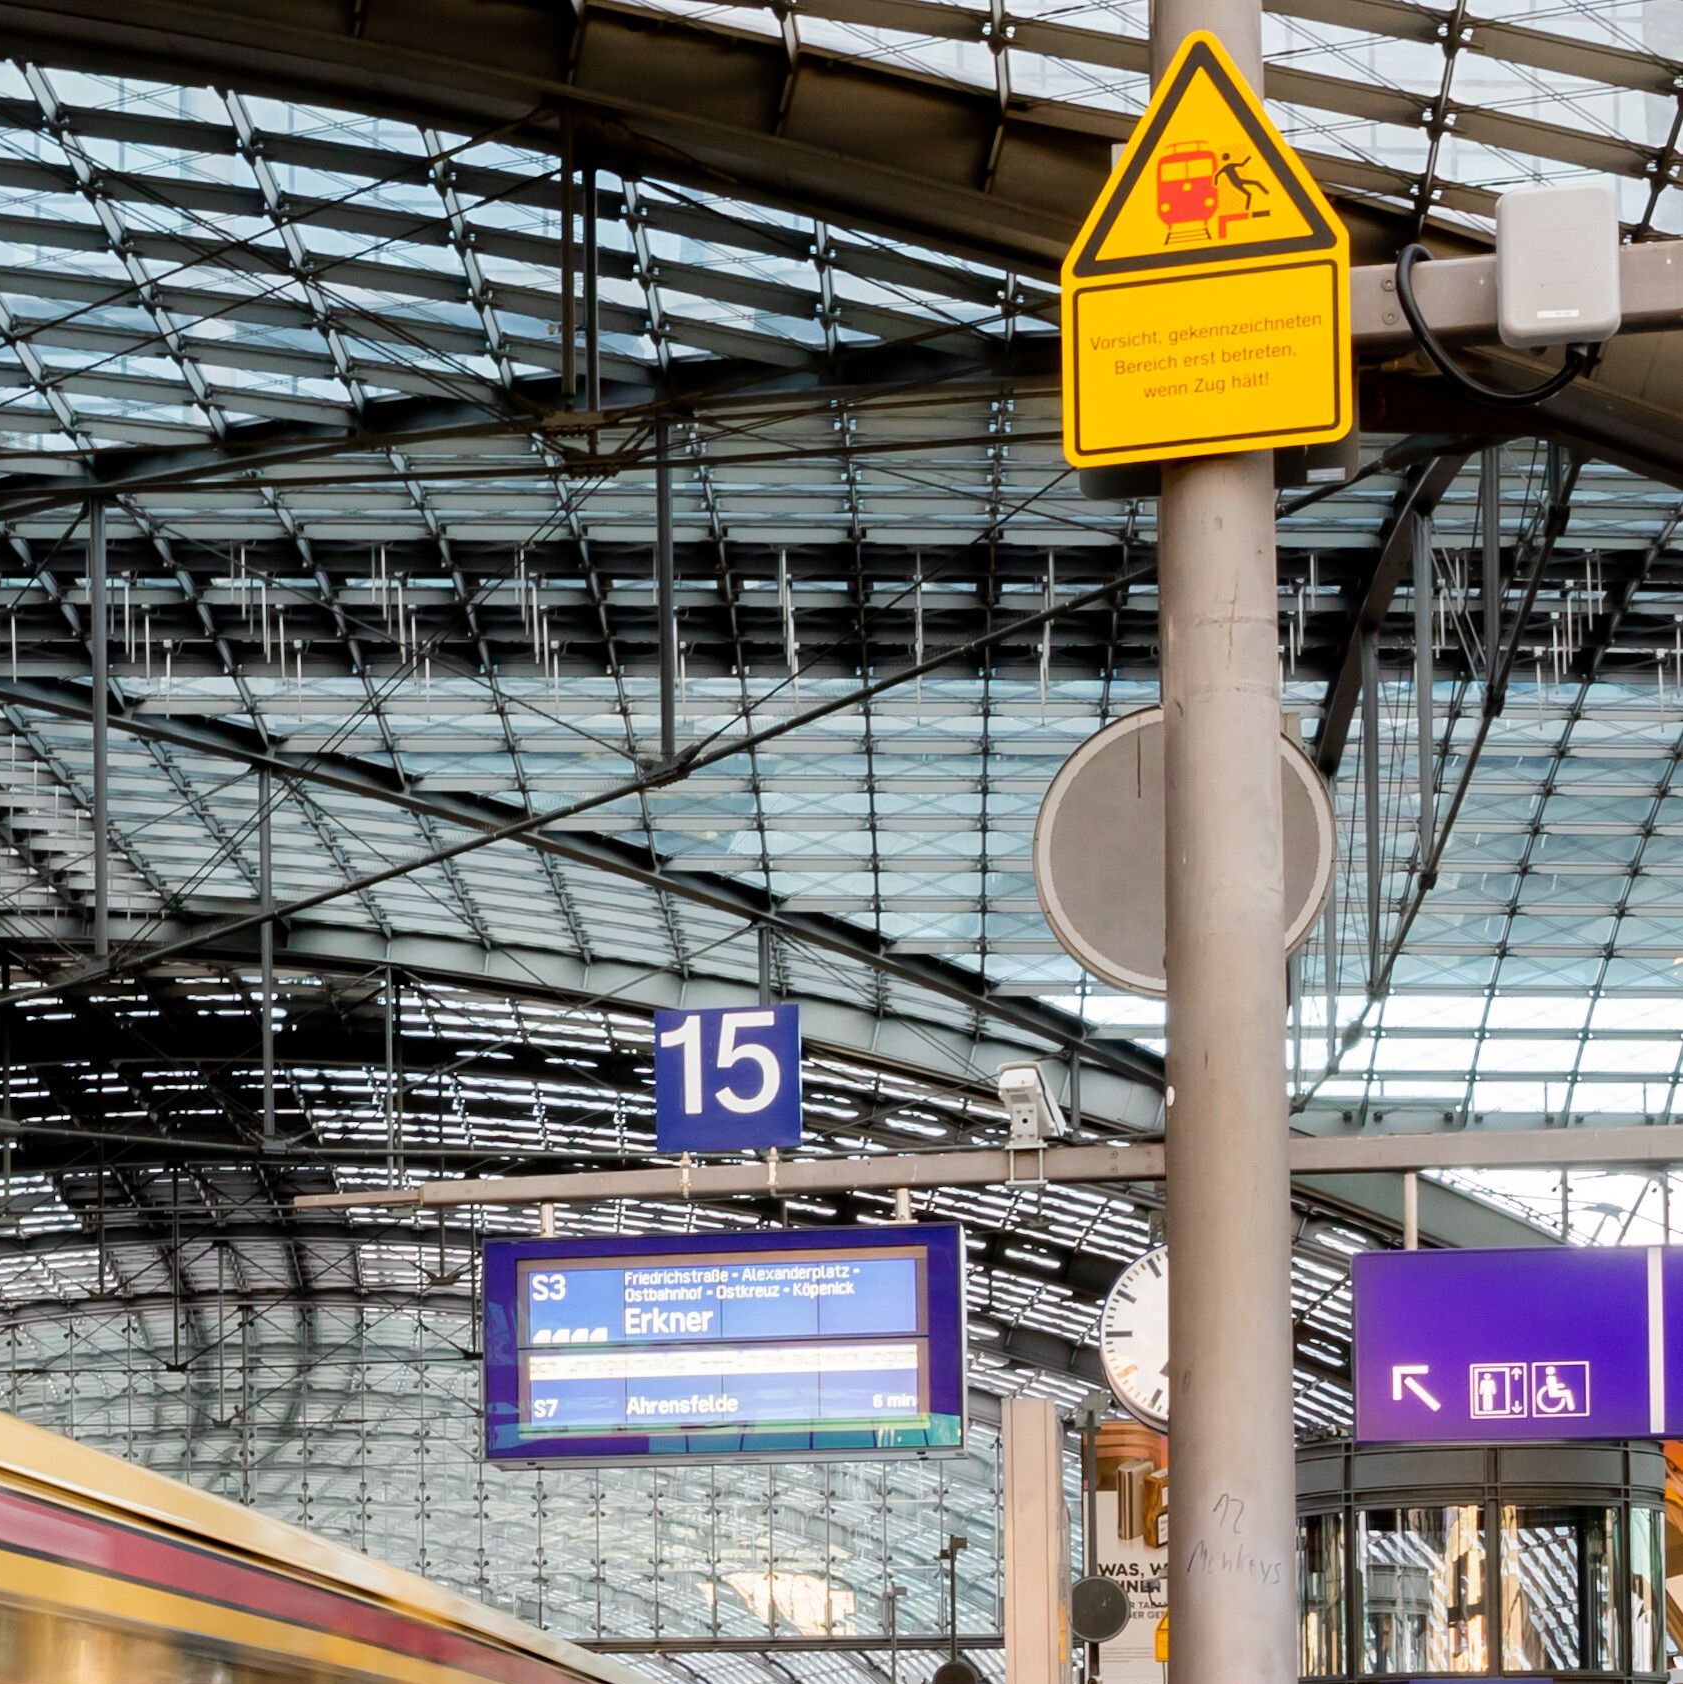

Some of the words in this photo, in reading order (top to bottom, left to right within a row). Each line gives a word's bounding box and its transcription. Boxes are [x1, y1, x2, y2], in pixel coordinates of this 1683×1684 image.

[1090, 331, 1162, 350] Vorsicht,
[1168, 313, 1322, 345] gekennzeichneten
[1115, 355, 1177, 375] Bereich
[1183, 351, 1215, 367] erst
[1221, 344, 1297, 364] betreten,
[1143, 382, 1188, 399] wenn
[1194, 377, 1225, 394] Zug
[1231, 371, 1269, 389] hält!
[660, 1011, 781, 1115] 15
[532, 1273, 566, 1301] S3
[624, 1269, 729, 1286] Friedrichstraße
[741, 1265, 851, 1283] Alexanderplatz
[624, 1286, 703, 1303] Ostbahnhof
[716, 1284, 781, 1300] Ostkreuz
[793, 1281, 855, 1299] Köpenick
[624, 1307, 714, 1335] Erkner
[533, 1399, 559, 1418] S7
[626, 1393, 739, 1416] Ahrensfelde
[872, 1393, 883, 1408] 6
[887, 1393, 918, 1408] min
[1098, 1563, 1144, 1579] WAS,
